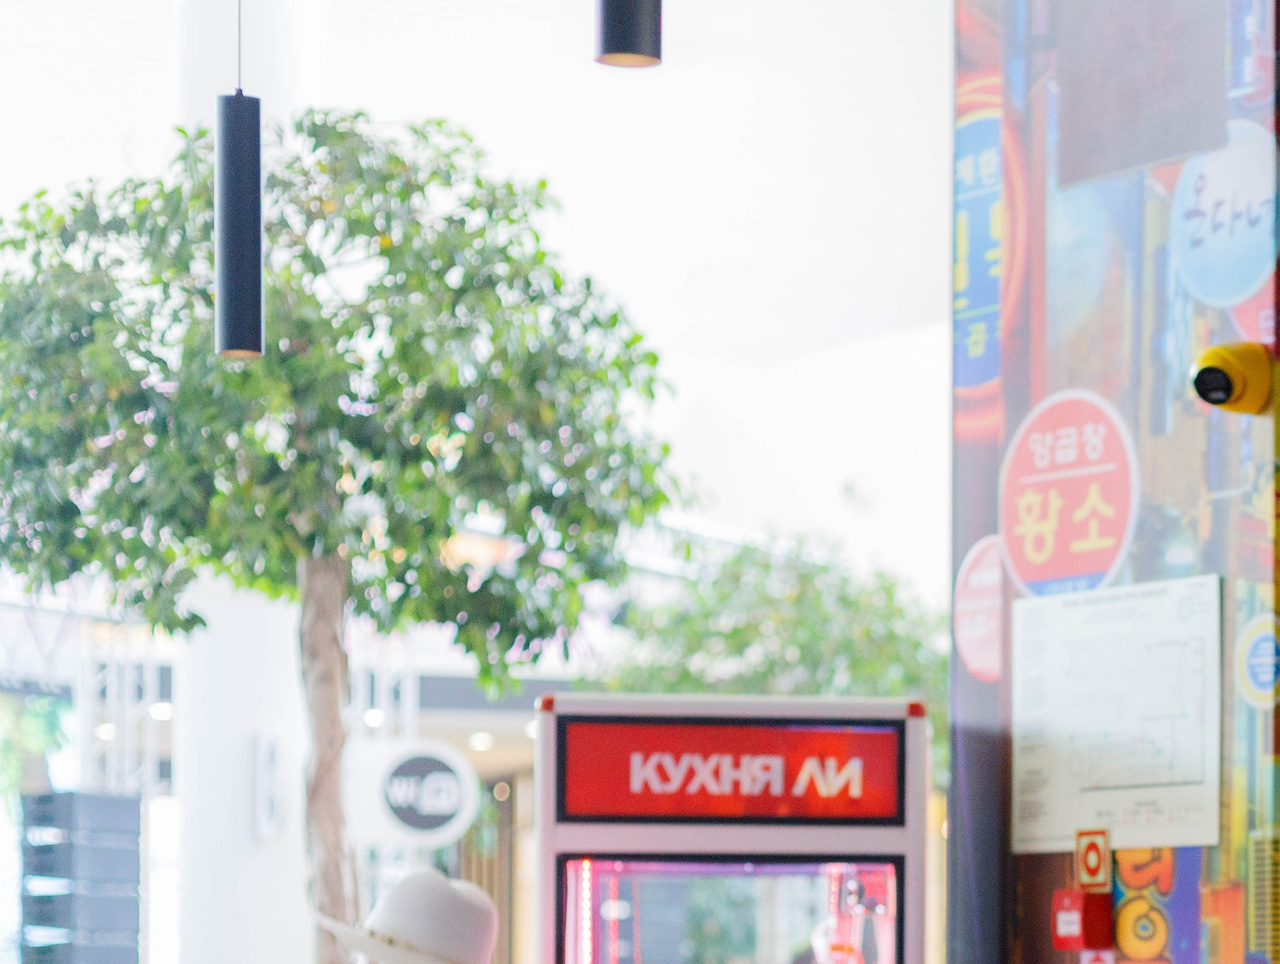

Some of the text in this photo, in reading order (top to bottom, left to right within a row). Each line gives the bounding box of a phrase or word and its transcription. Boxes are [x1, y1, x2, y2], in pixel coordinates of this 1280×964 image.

[1014, 483, 1117, 566] 황소
[629, 751, 864, 798] КУХНЯ ЛИ
